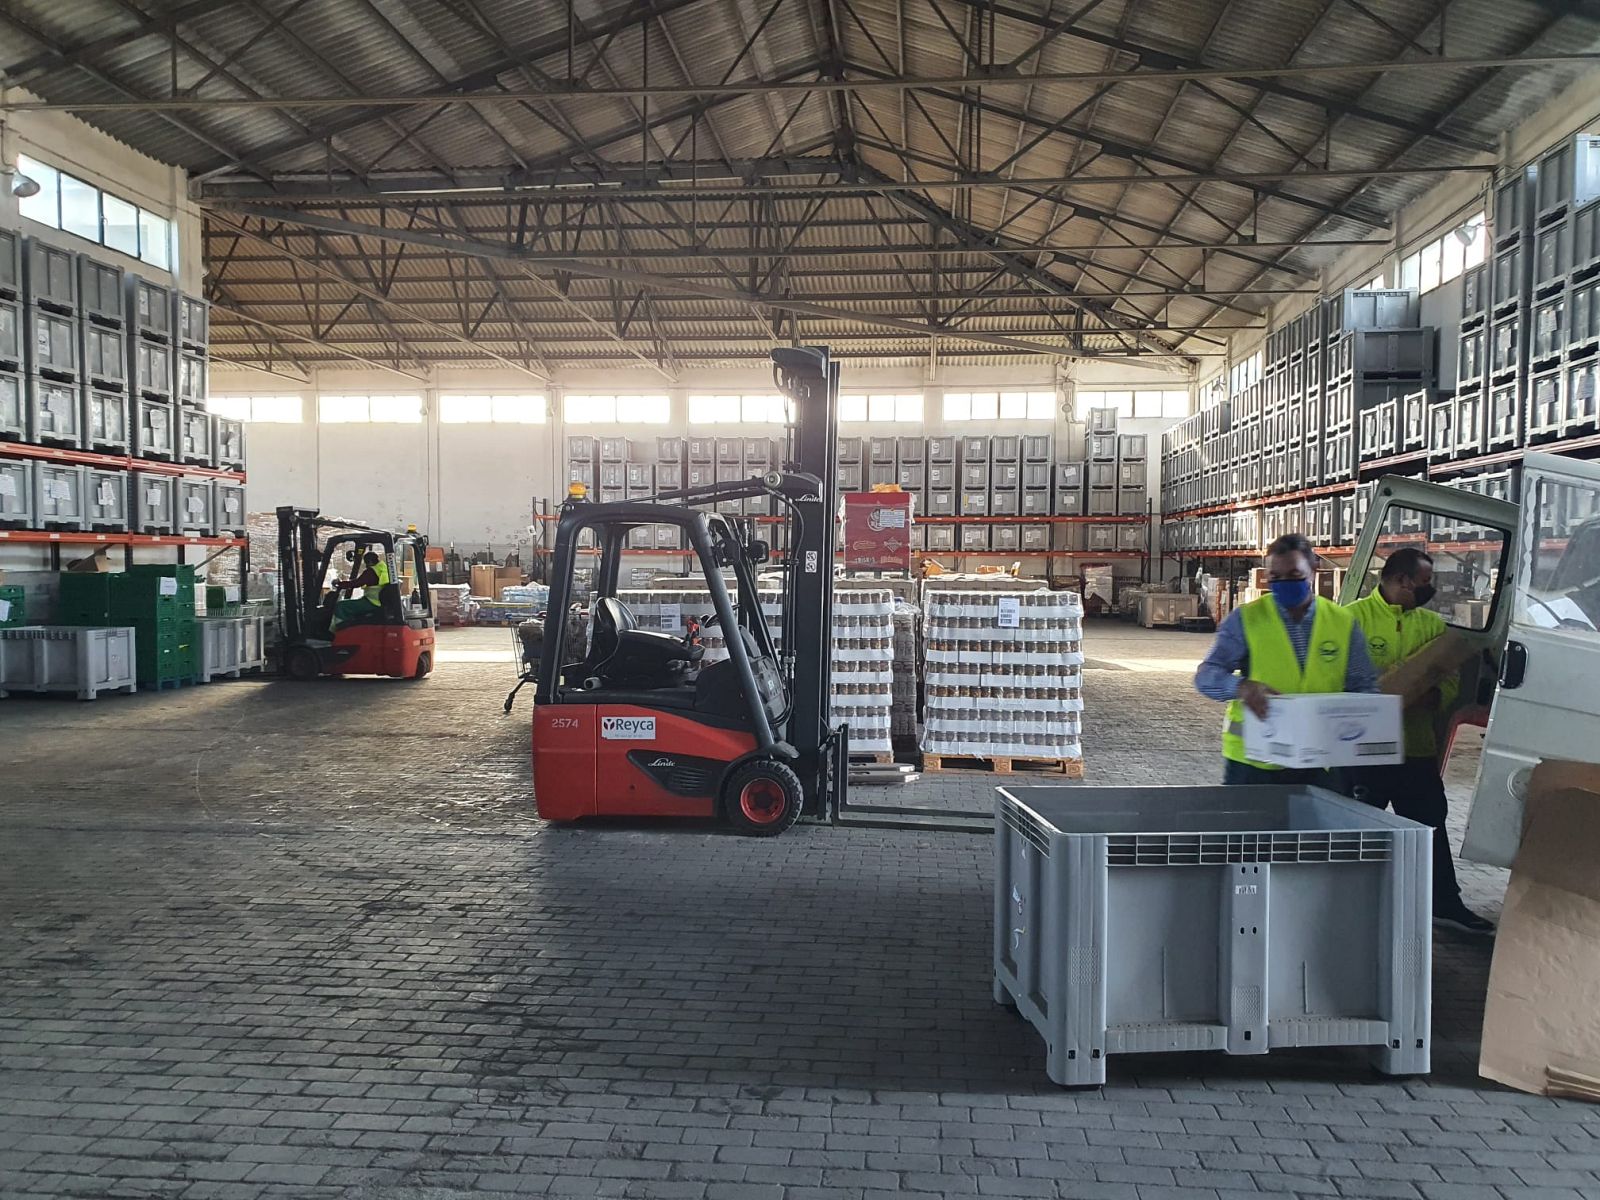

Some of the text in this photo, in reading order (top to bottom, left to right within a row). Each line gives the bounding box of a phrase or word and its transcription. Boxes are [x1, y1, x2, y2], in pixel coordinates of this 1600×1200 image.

[551, 718, 579, 728] 2574
[616, 718, 654, 734] Reyca
[647, 757, 676, 767] Linde
